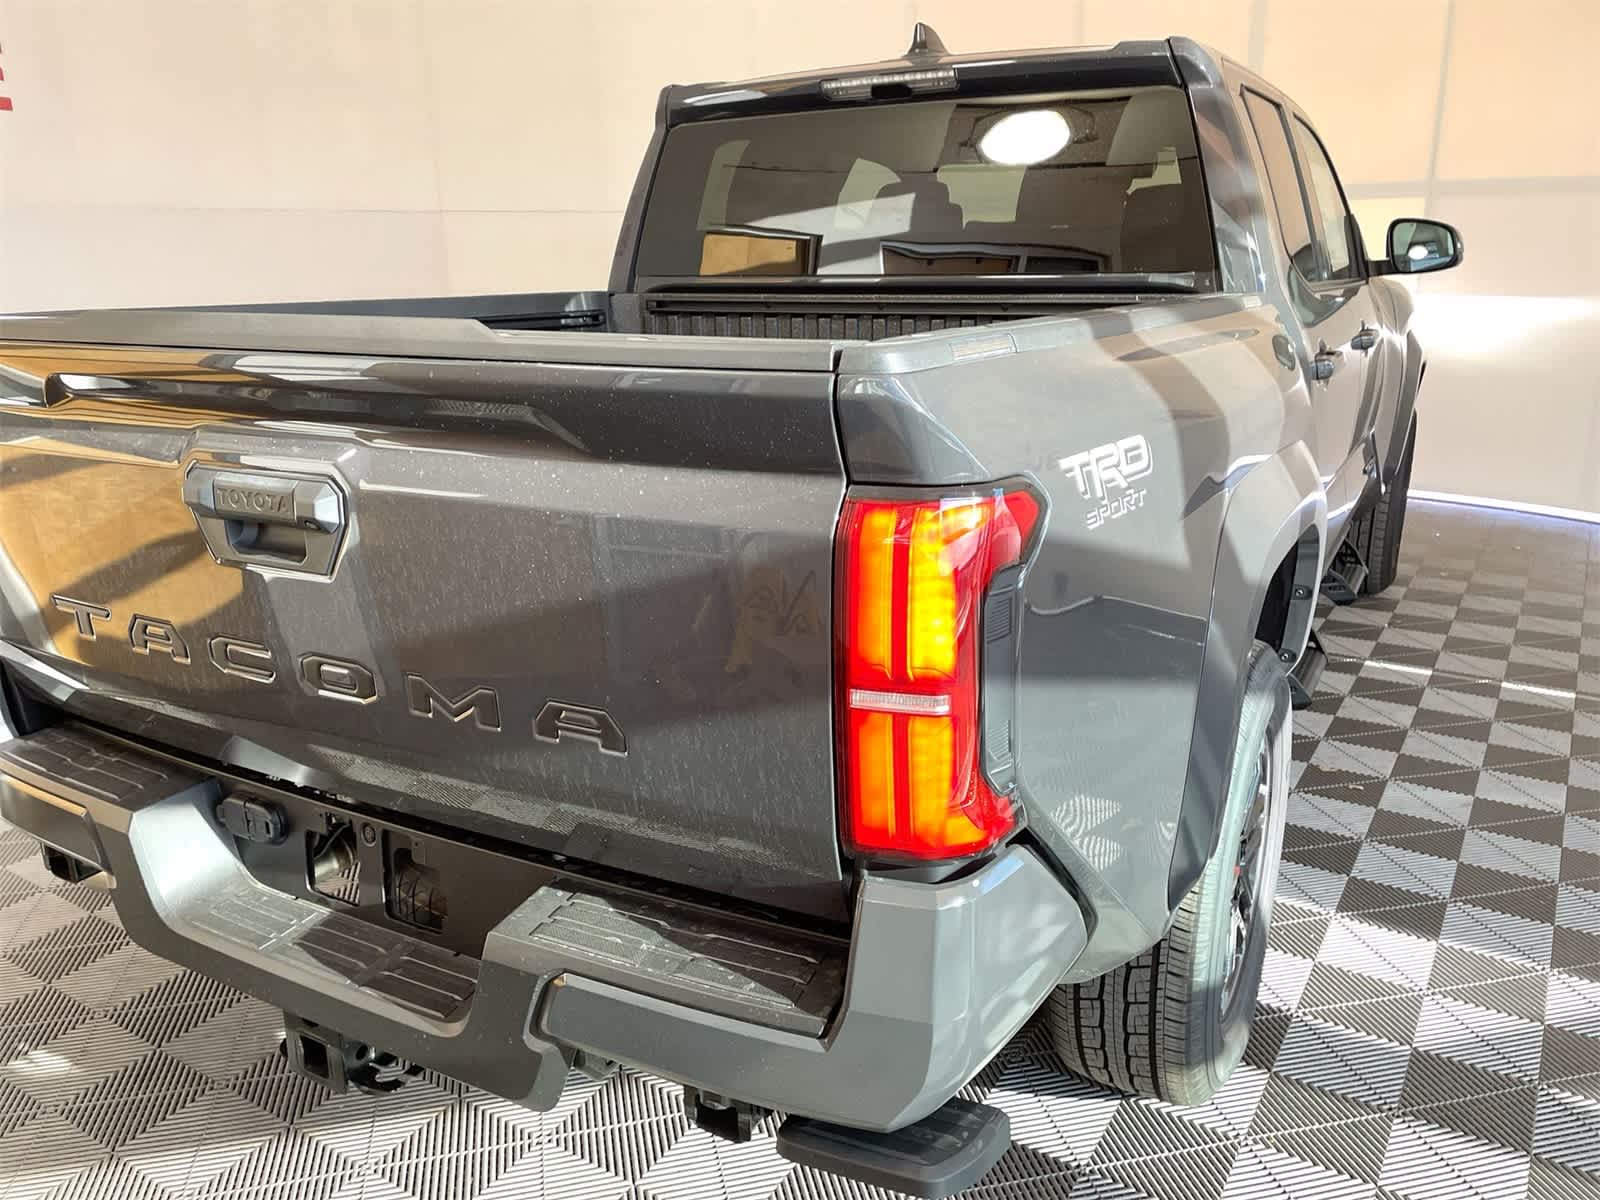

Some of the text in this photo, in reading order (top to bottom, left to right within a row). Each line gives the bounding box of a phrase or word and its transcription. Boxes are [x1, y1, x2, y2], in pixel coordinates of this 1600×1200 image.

[1058, 434, 1153, 503] TRD
[216, 488, 289, 513] TOYOTA
[1086, 488, 1147, 530] SPORT
[52, 595, 628, 757] TACOMA
